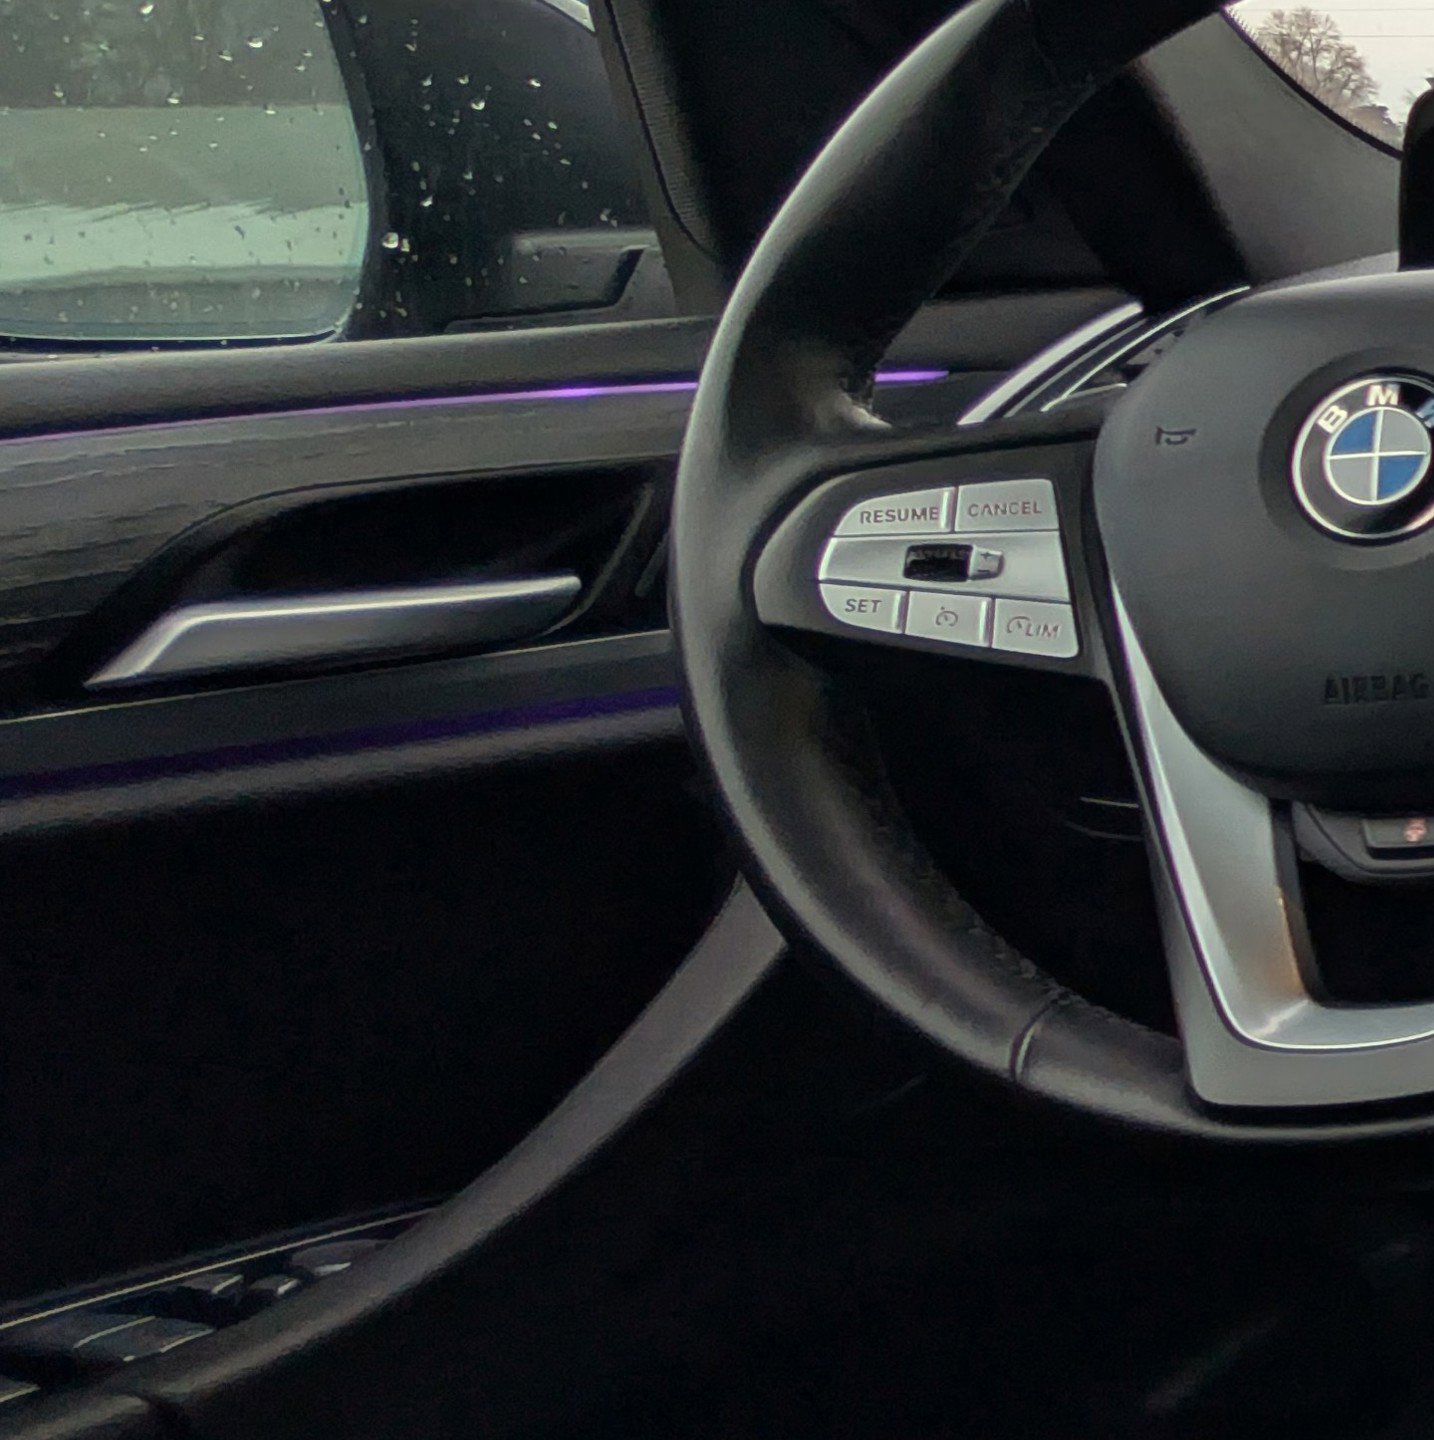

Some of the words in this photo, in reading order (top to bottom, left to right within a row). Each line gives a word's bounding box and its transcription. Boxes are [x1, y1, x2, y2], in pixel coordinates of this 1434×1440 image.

[860, 506, 939, 525] RESUME
[968, 500, 1043, 518] CANCEL
[845, 598, 882, 614] SET
[1026, 623, 1061, 638] LIM
[1324, 673, 1430, 705] AIRBAG
